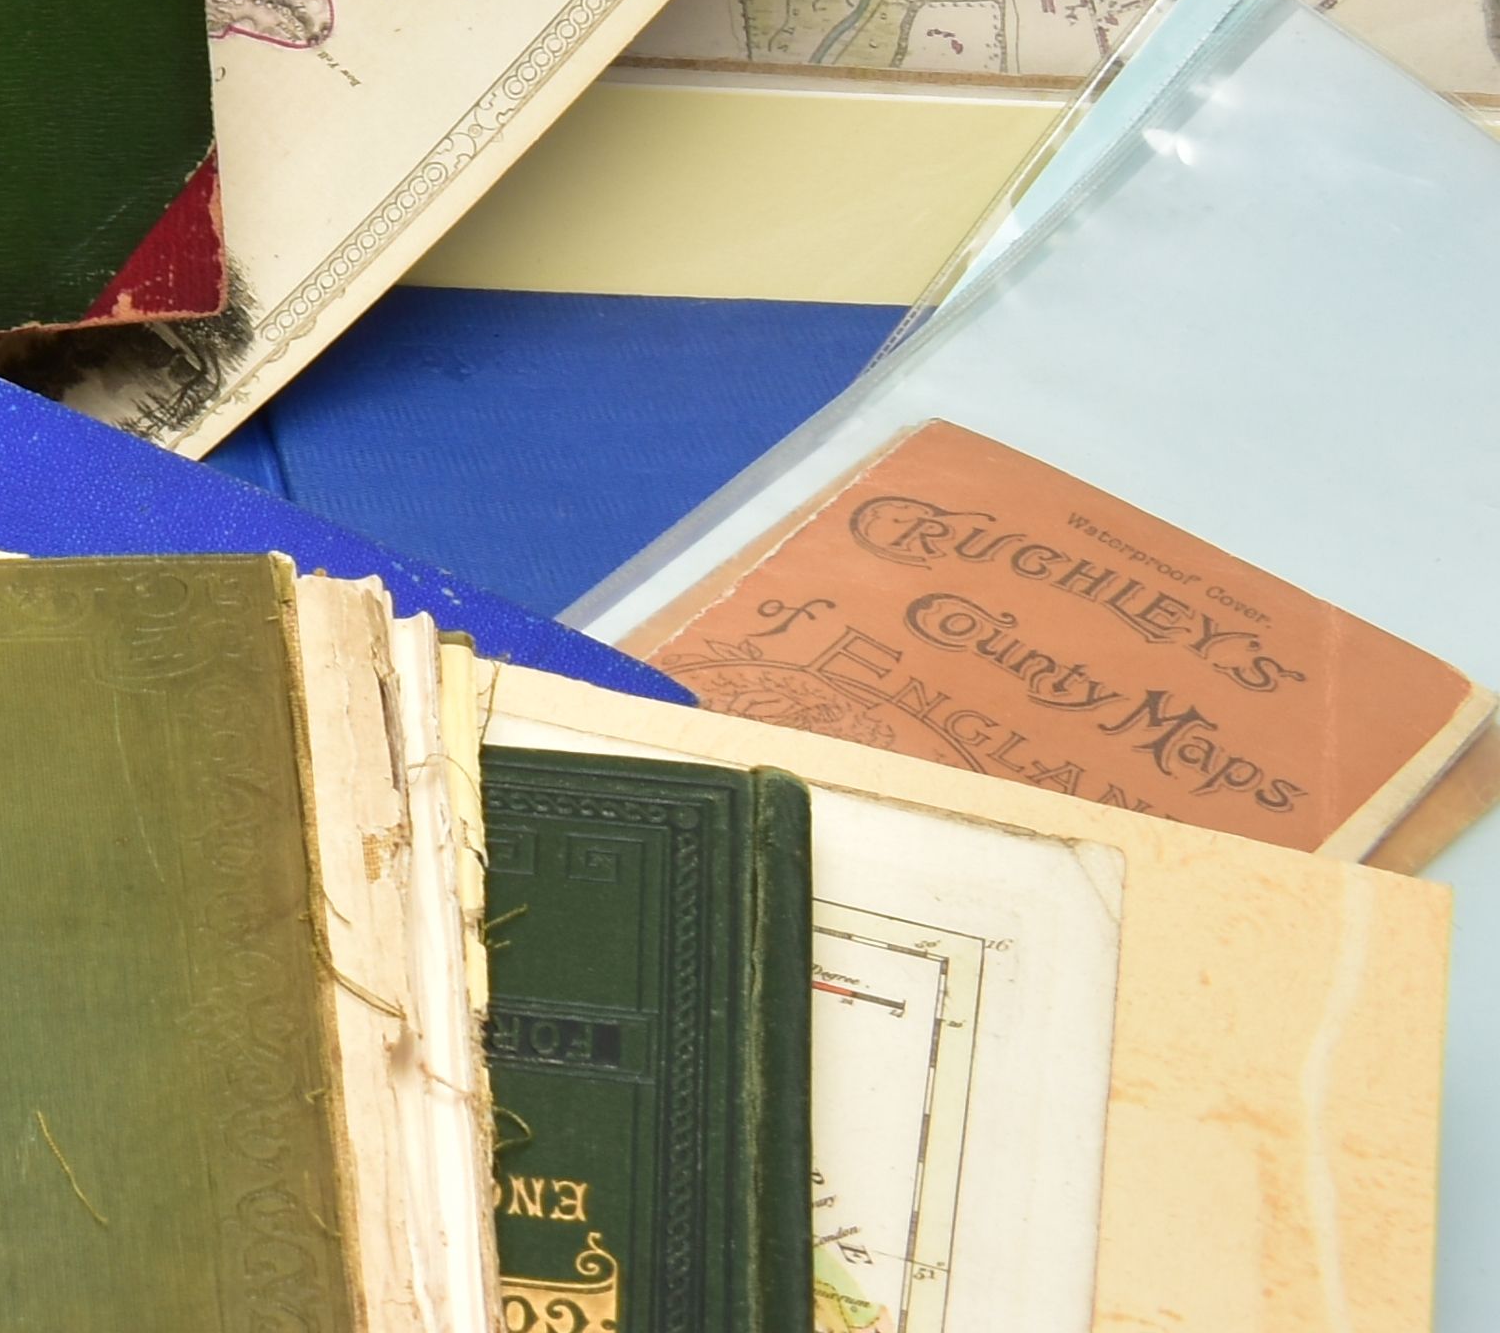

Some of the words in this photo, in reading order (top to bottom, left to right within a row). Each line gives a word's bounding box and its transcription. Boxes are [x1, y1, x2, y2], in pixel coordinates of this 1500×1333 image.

[749, 597, 836, 636] of
[849, 496, 1306, 694] CRUCHLEY'S
[1066, 511, 1203, 587] Waterproof
[1205, 584, 1273, 629] Cover.
[902, 592, 1122, 711] County
[1099, 688, 1308, 813] Maps
